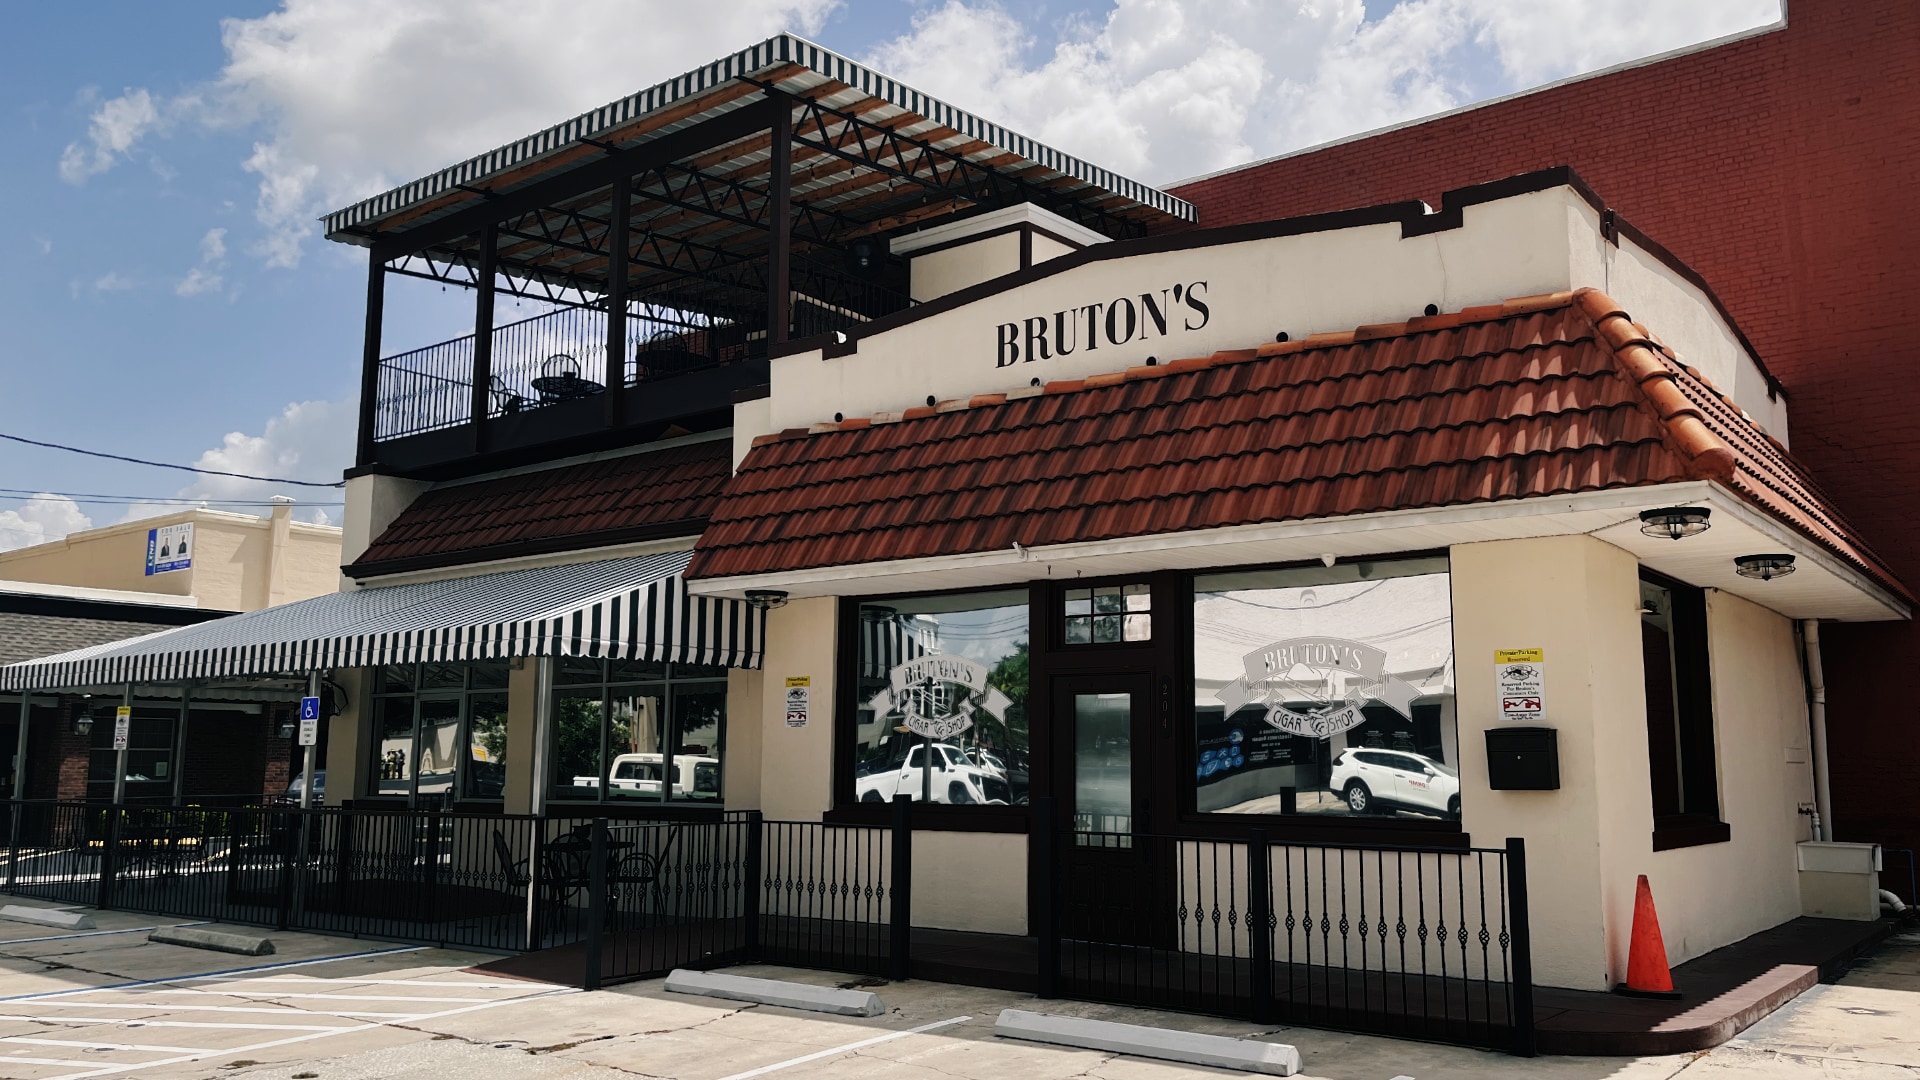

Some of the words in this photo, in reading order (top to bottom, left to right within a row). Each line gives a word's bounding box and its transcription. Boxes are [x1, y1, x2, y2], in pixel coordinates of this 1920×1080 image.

[995, 280, 1210, 369] BRUTON'S
[1264, 643, 1363, 673] BRUTON'S
[905, 659, 974, 685] BRUTON'S
[908, 715, 929, 733] CIGAR
[947, 715, 966, 734] SHOP
[1273, 710, 1302, 732] CIGAR
[1328, 709, 1354, 731] SHOP
